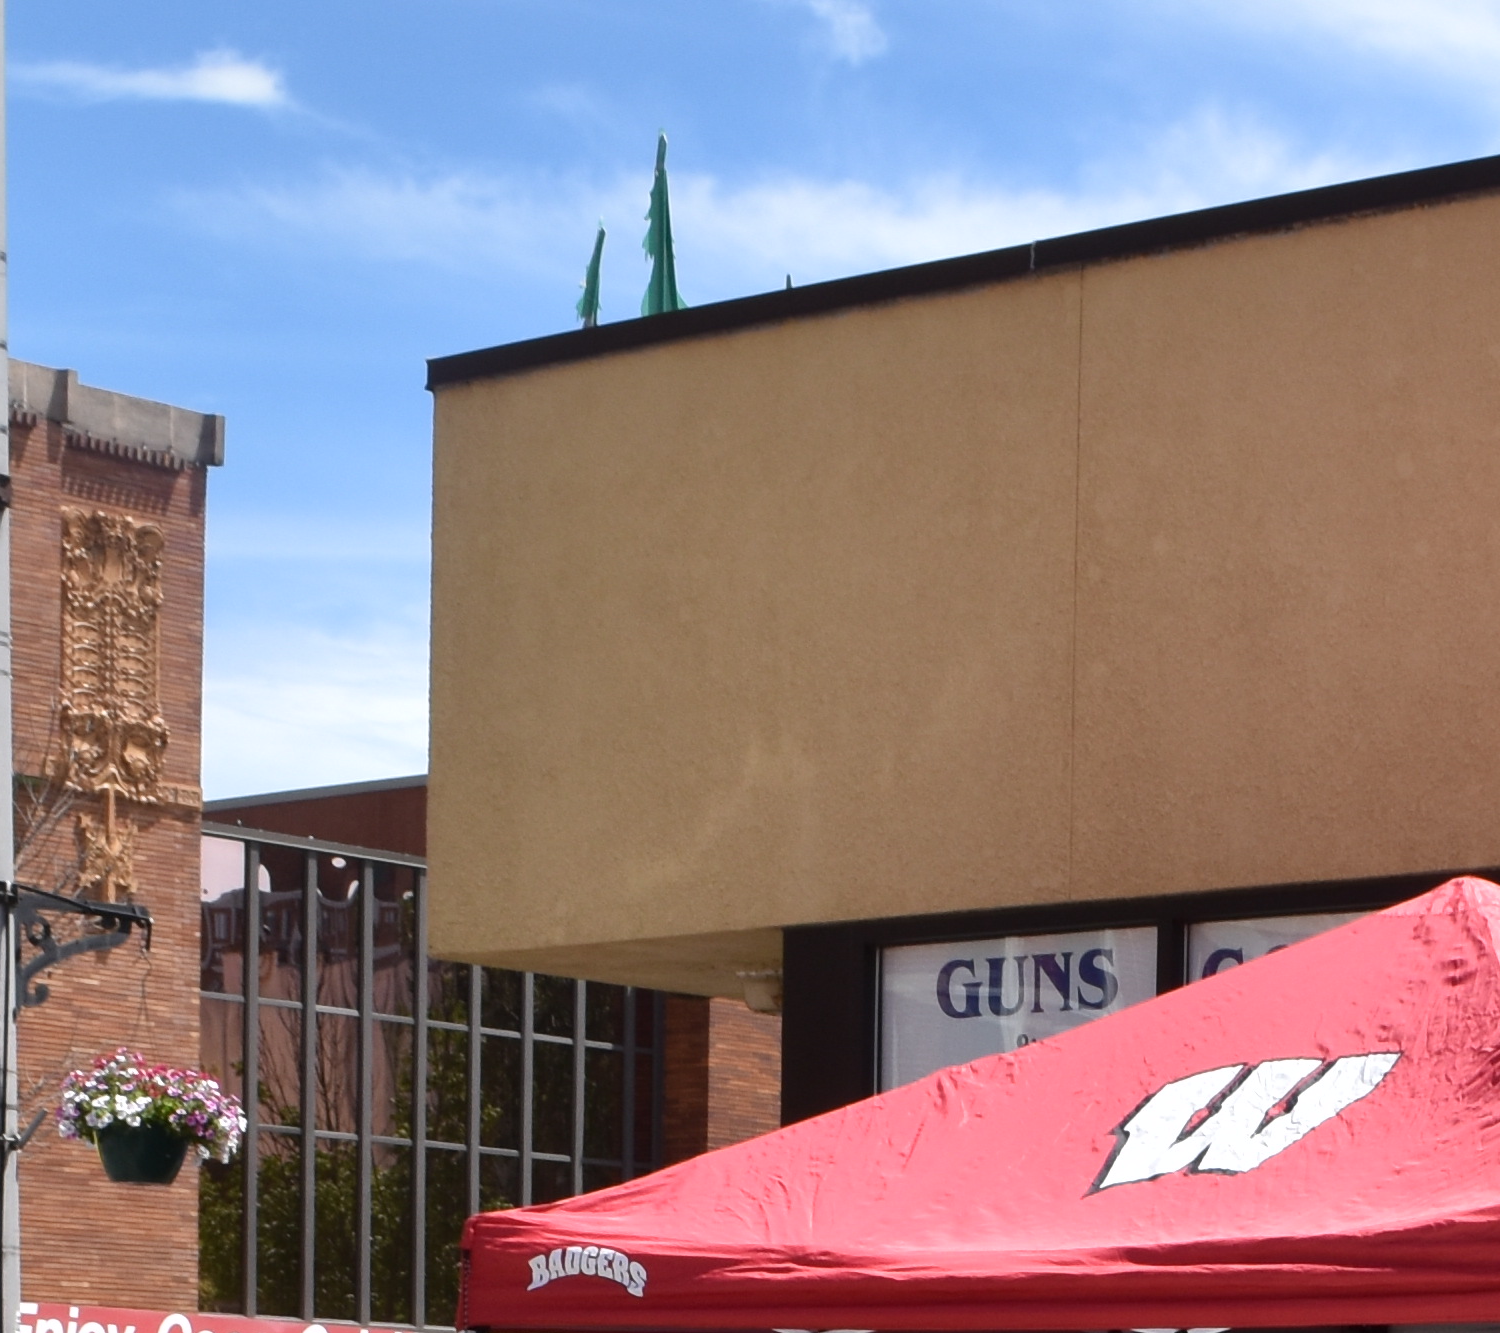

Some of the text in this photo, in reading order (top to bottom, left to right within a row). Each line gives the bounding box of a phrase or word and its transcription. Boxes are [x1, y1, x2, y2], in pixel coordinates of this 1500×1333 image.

[936, 948, 1119, 1019] GUNS
[1083, 1050, 1401, 1197] W
[526, 1246, 649, 1298] BADGERS
